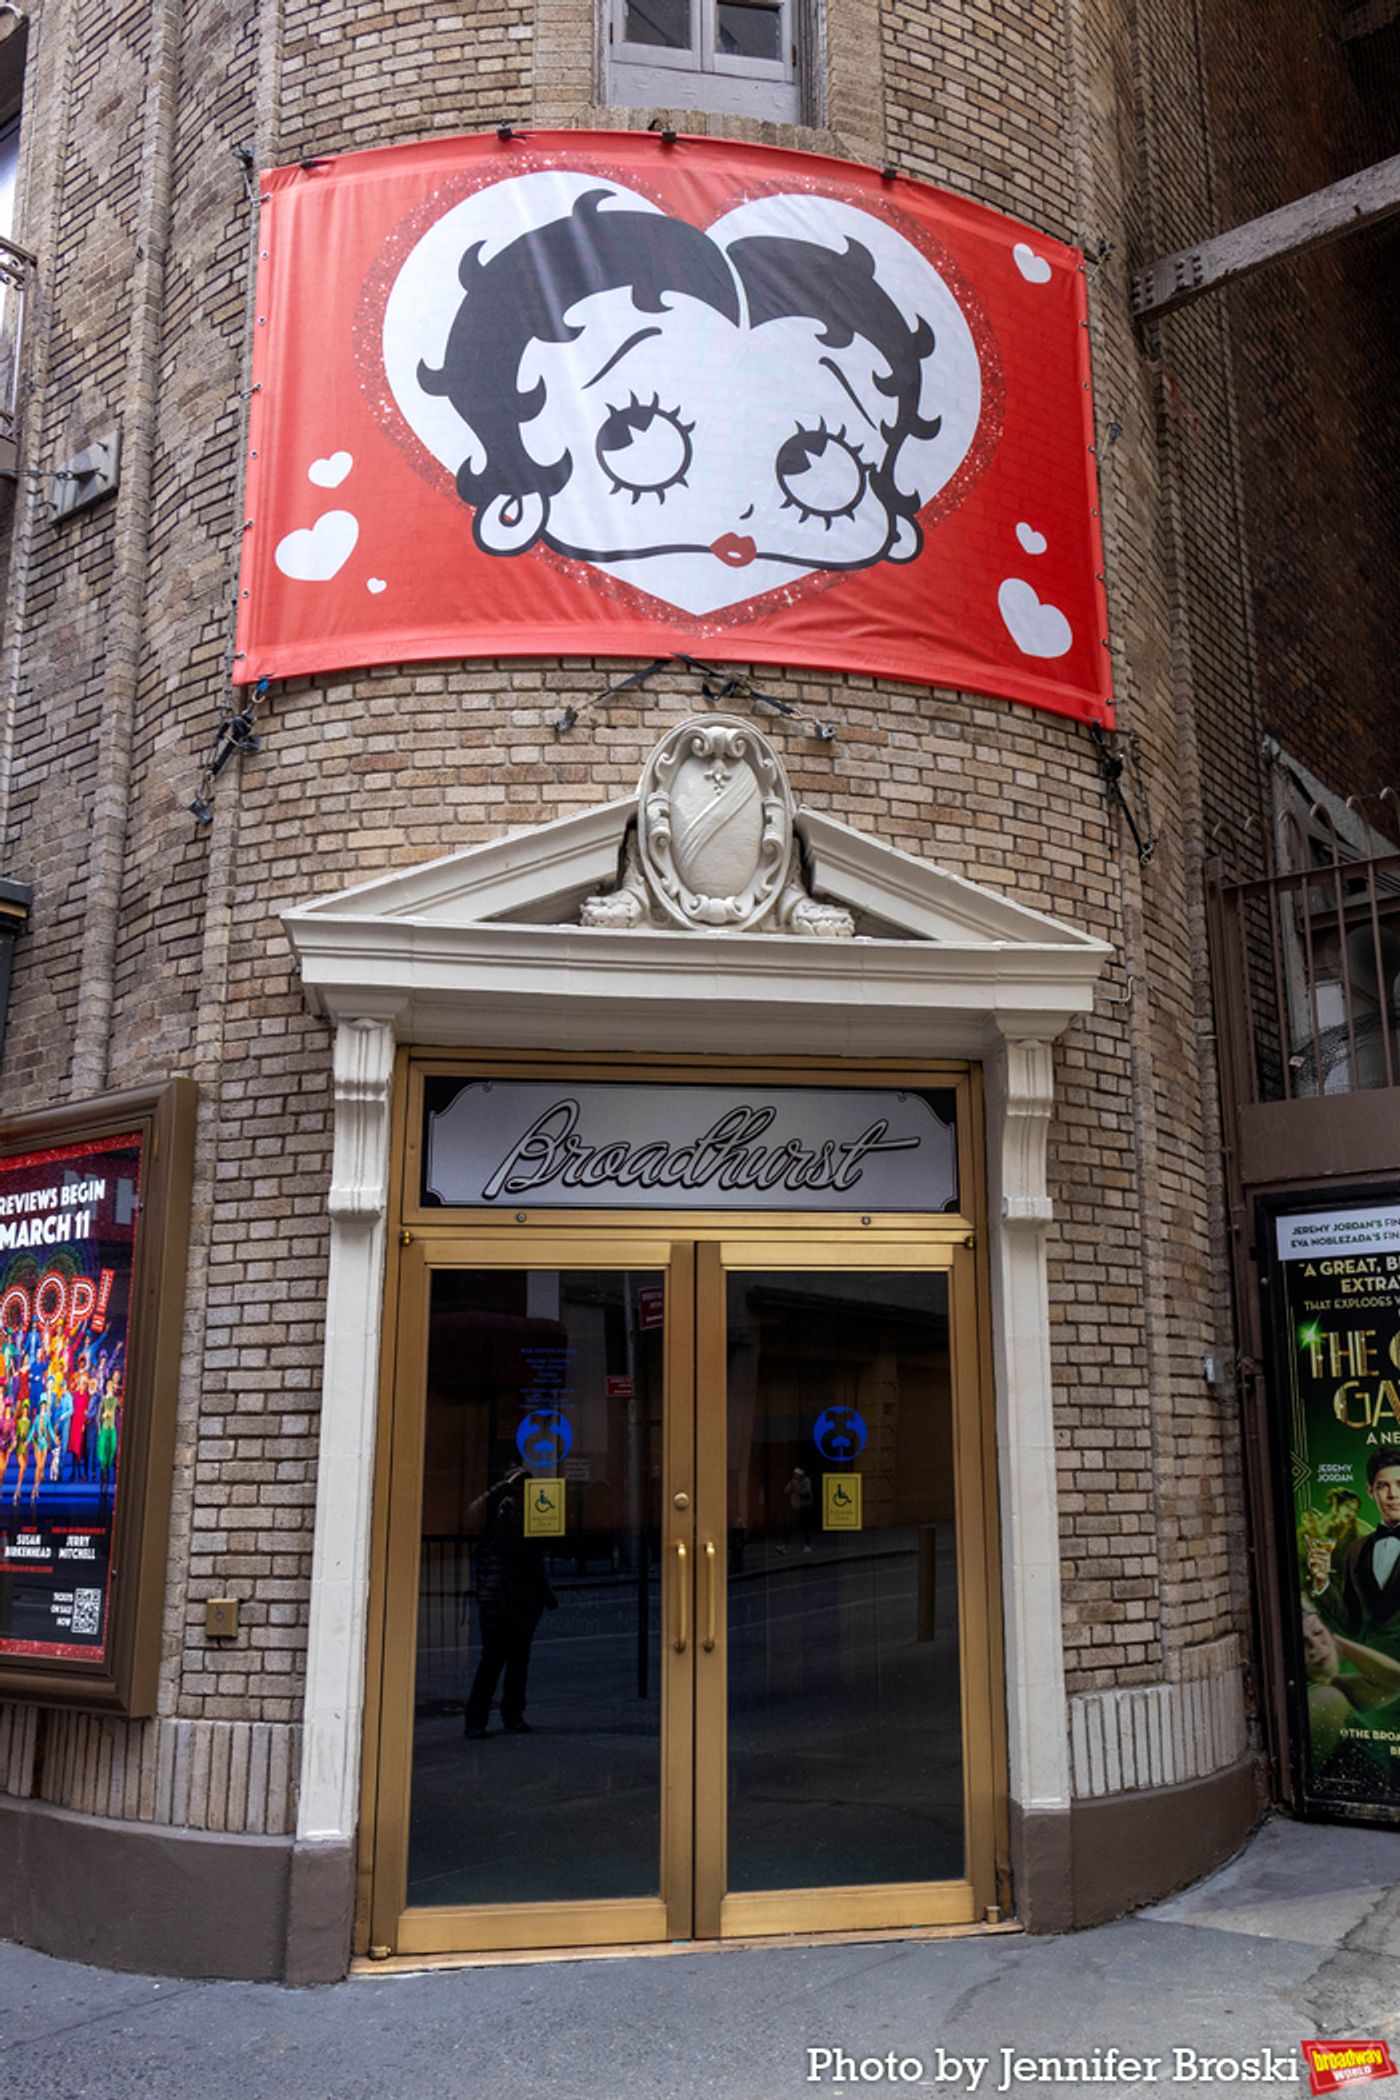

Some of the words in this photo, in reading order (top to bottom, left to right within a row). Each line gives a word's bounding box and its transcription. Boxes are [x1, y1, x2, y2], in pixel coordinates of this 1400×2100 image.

[482, 1098, 921, 1200] Broadhurst
[60, 1179, 105, 1207] BEGIN
[0, 1212, 71, 1249] MARCH
[75, 1210, 90, 1239] 11
[1290, 1238, 1309, 1249] EVA
[1320, 1258, 1382, 1276] GREAT,
[1303, 1299, 1331, 1311] THAT
[1334, 1296, 1393, 1309] EXPLODES
[1305, 1330, 1379, 1379] THE
[1333, 1379, 1400, 1429] GA
[1366, 1432, 1378, 1445] A
